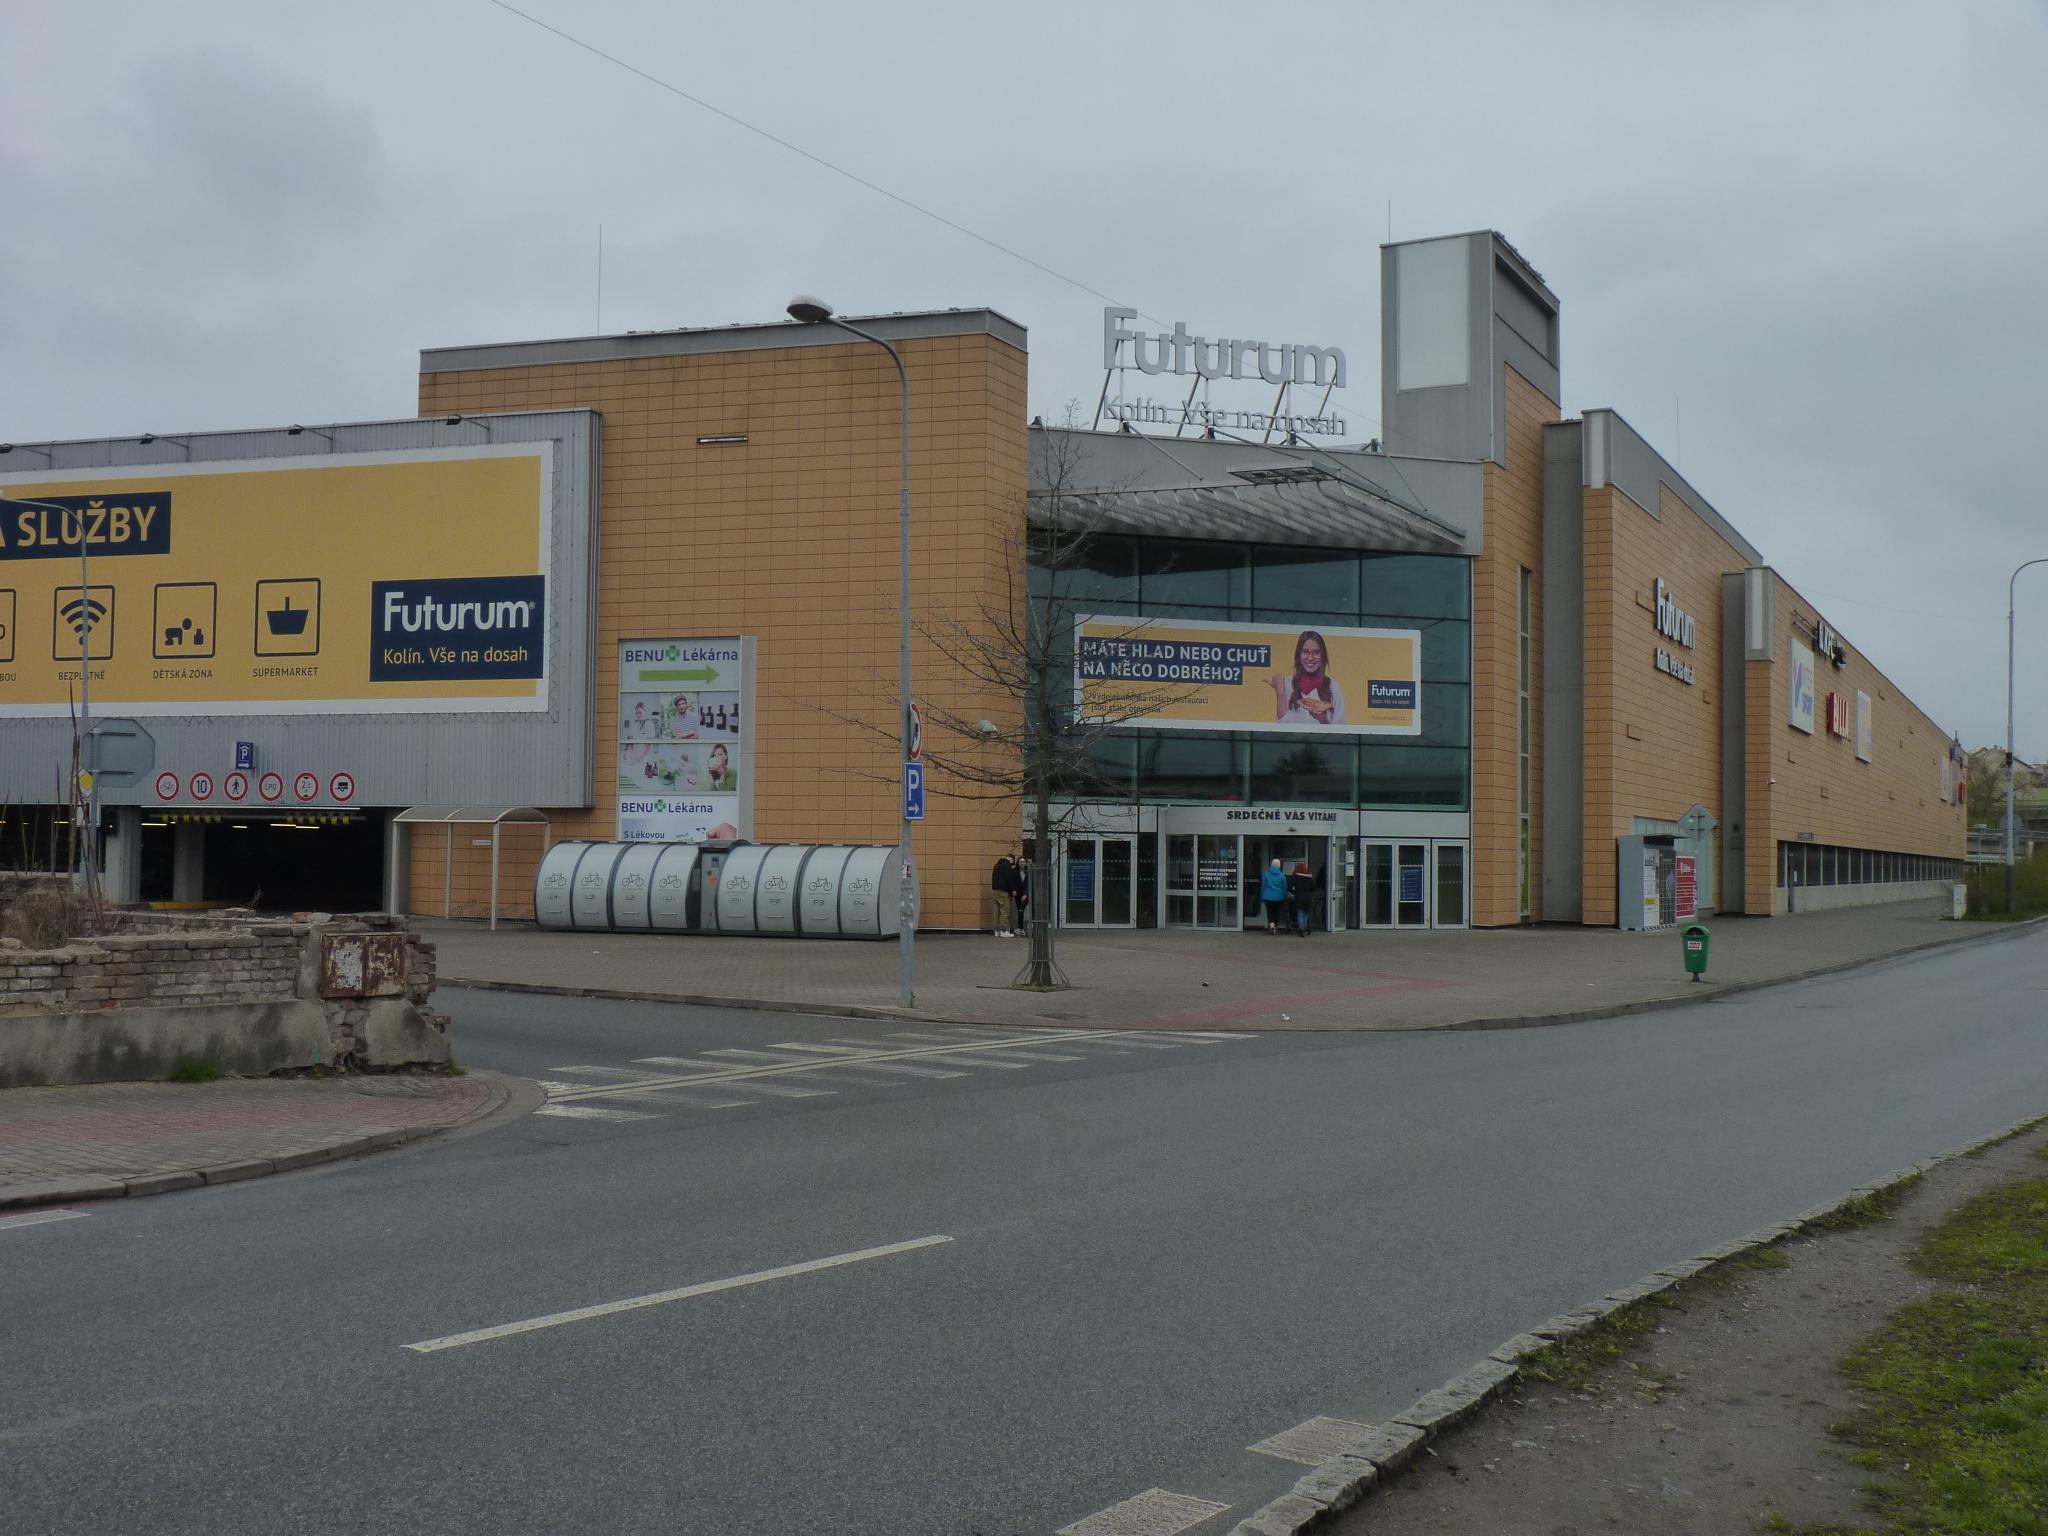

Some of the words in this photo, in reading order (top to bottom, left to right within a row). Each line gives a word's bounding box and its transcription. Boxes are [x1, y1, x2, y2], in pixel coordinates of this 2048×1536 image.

[1104, 307, 1346, 388] Futurum
[1103, 396, 1174, 424] Kolín.
[1182, 400, 1227, 427] Vše
[1236, 411, 1265, 430] na
[1274, 408, 1347, 436] dosah
[17, 500, 157, 547] SLUŽBY
[384, 648, 425, 664] Kolín.
[430, 646, 456, 663] Vše
[461, 650, 479, 663] na
[484, 646, 528, 662] dosah
[625, 650, 665, 662] BENU
[683, 648, 738, 662] Lékárna
[1083, 640, 1127, 657] MÁTE
[1132, 644, 1175, 659] HLAD
[1180, 646, 1222, 661] NEBO
[1227, 647, 1268, 664] CHUŤ
[58, 669, 105, 681] BEZPLTNÉ
[152, 668, 187, 680] DĚTSKÁ
[252, 667, 319, 678] SUPERMARKET
[1111, 660, 1153, 678] NĚCO
[1158, 664, 1241, 681] DOBRÉHO?
[1371, 684, 1411, 696] Futurum
[196, 779, 207, 794] 10
[908, 769, 920, 802] P
[621, 802, 653, 813] BENU
[668, 801, 713, 813] Lékárna
[1226, 808, 1281, 820] SRDEČNĚ
[1284, 809, 1305, 821] VÁS
[1308, 811, 1337, 822] VÍTÁME
